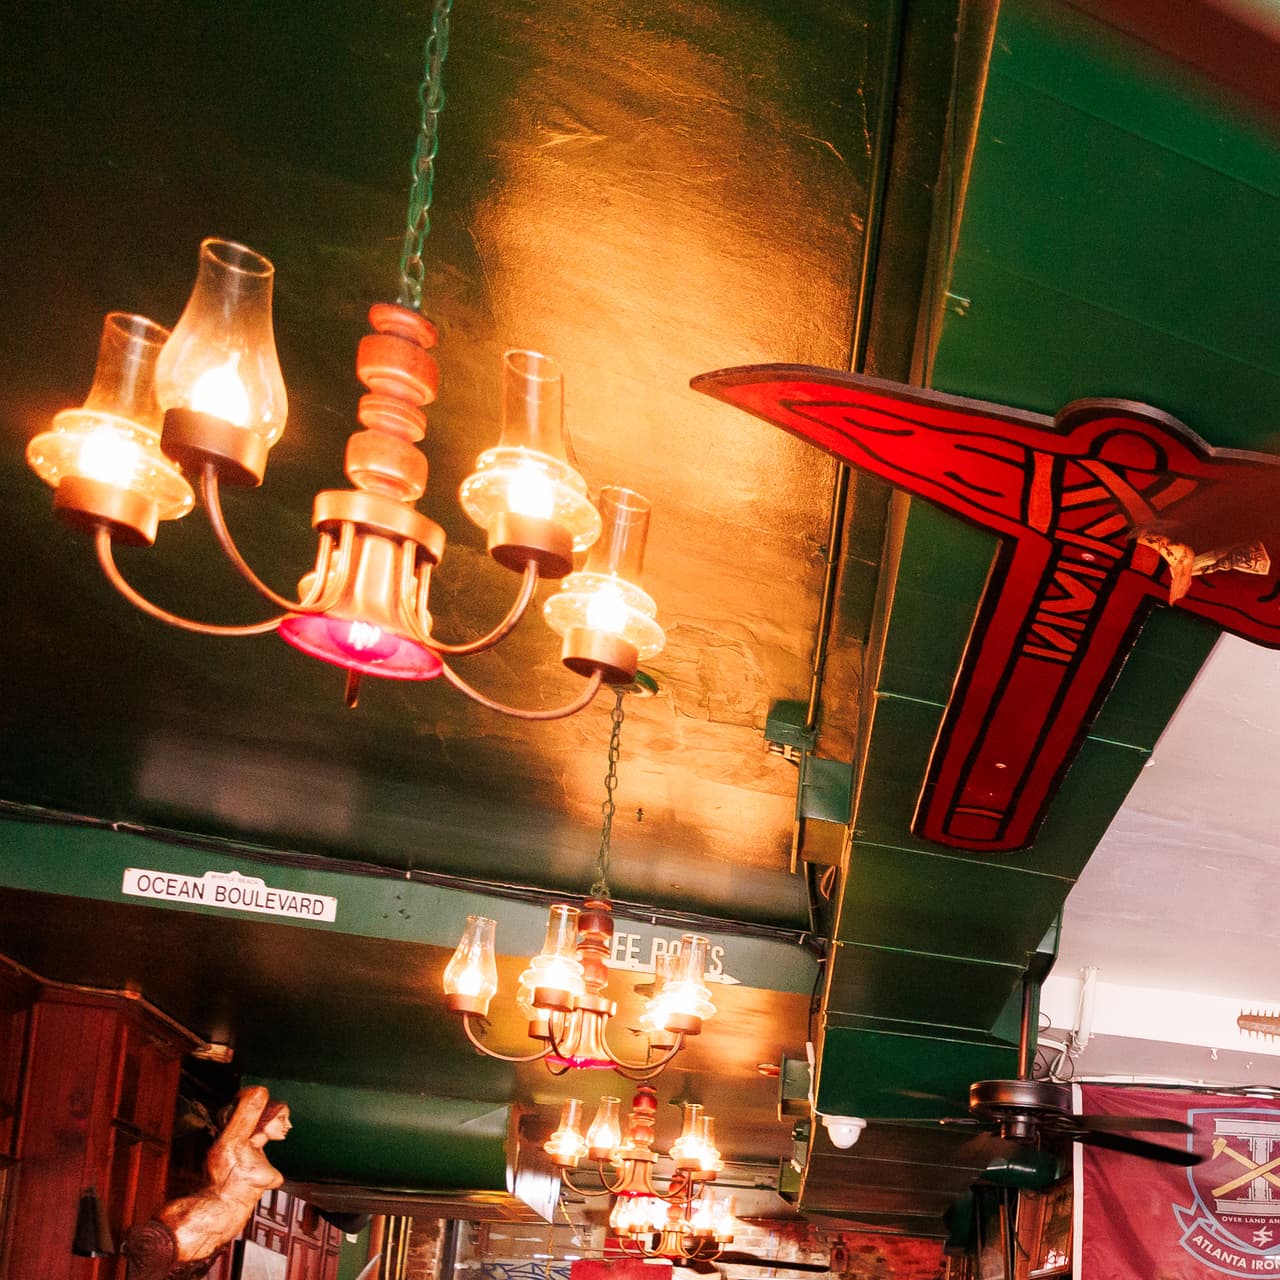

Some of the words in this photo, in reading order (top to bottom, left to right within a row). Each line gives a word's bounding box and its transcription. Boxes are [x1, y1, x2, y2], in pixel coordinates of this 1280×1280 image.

[137, 875, 205, 899] OCEAN
[215, 885, 325, 916] BOULEVARD
[1222, 1215, 1242, 1223] OVER
[1192, 1235, 1247, 1269] ATLANTA
